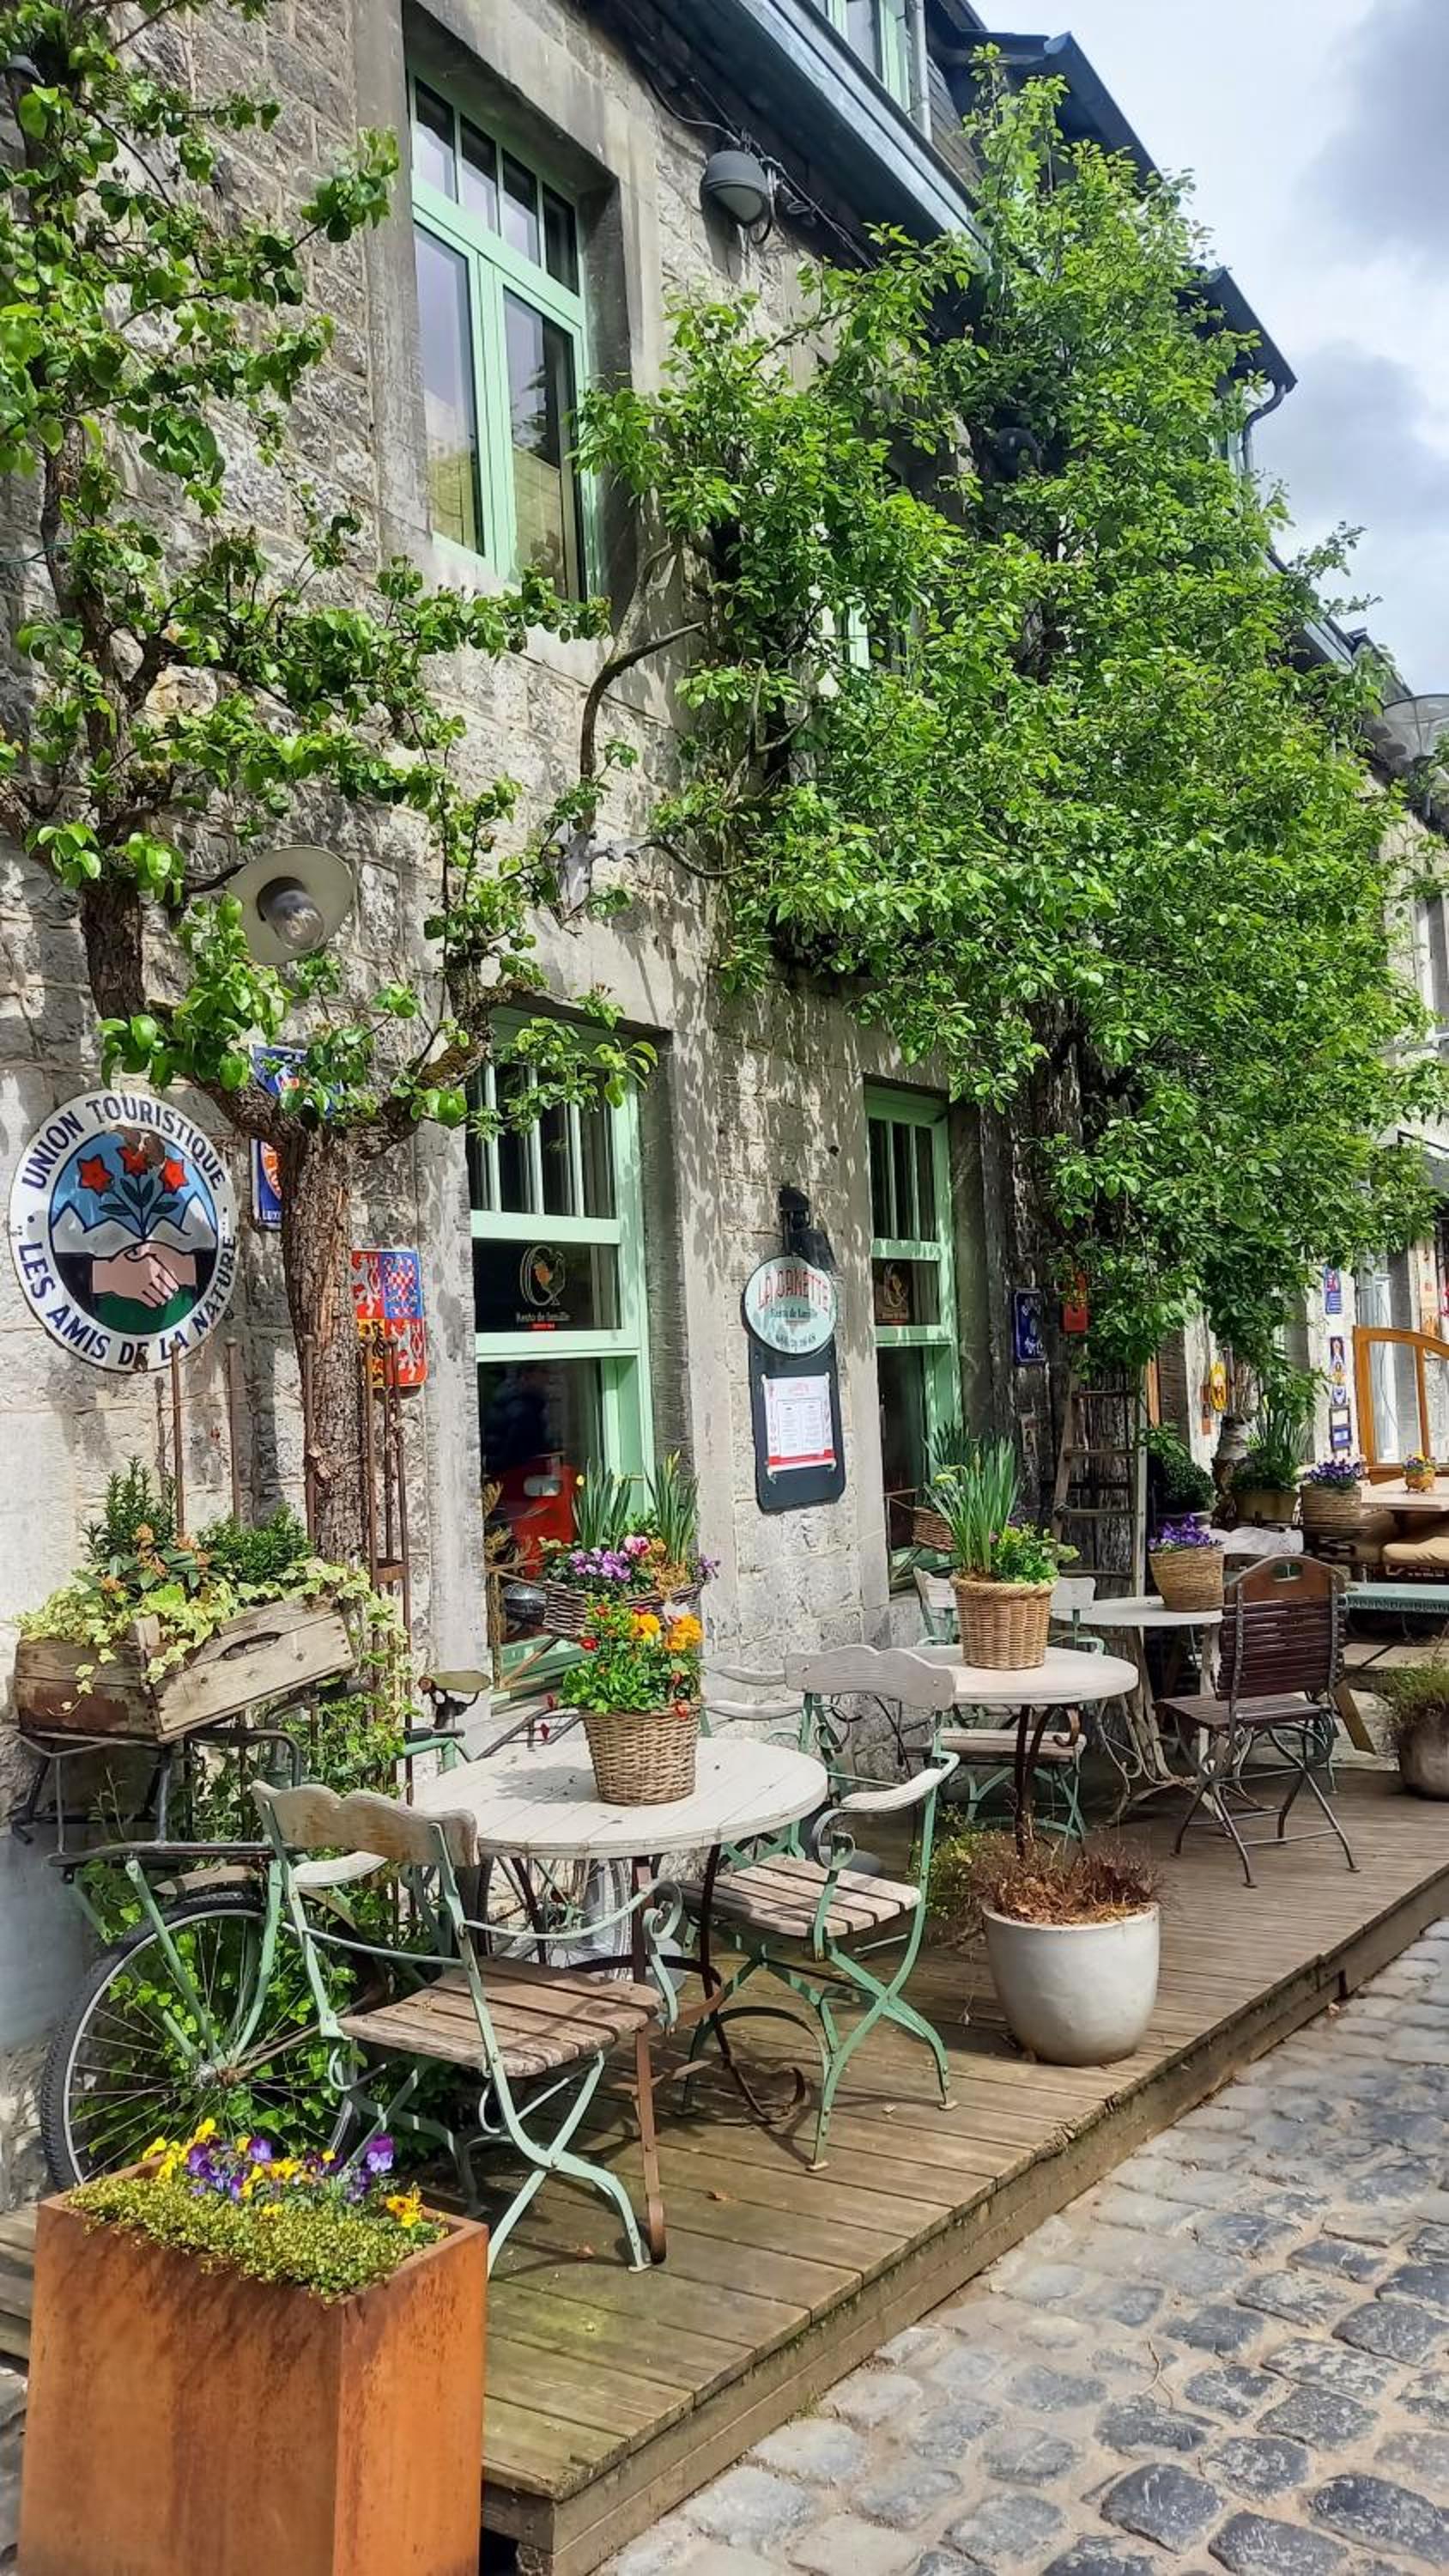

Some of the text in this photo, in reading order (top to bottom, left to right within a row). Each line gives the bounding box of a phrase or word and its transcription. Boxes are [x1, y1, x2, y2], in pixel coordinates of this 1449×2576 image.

[21, 1097, 226, 1191] UNION TOURISTIQUE
[46, 1304, 111, 1359] AMIS
[160, 1330, 190, 1360] LA
